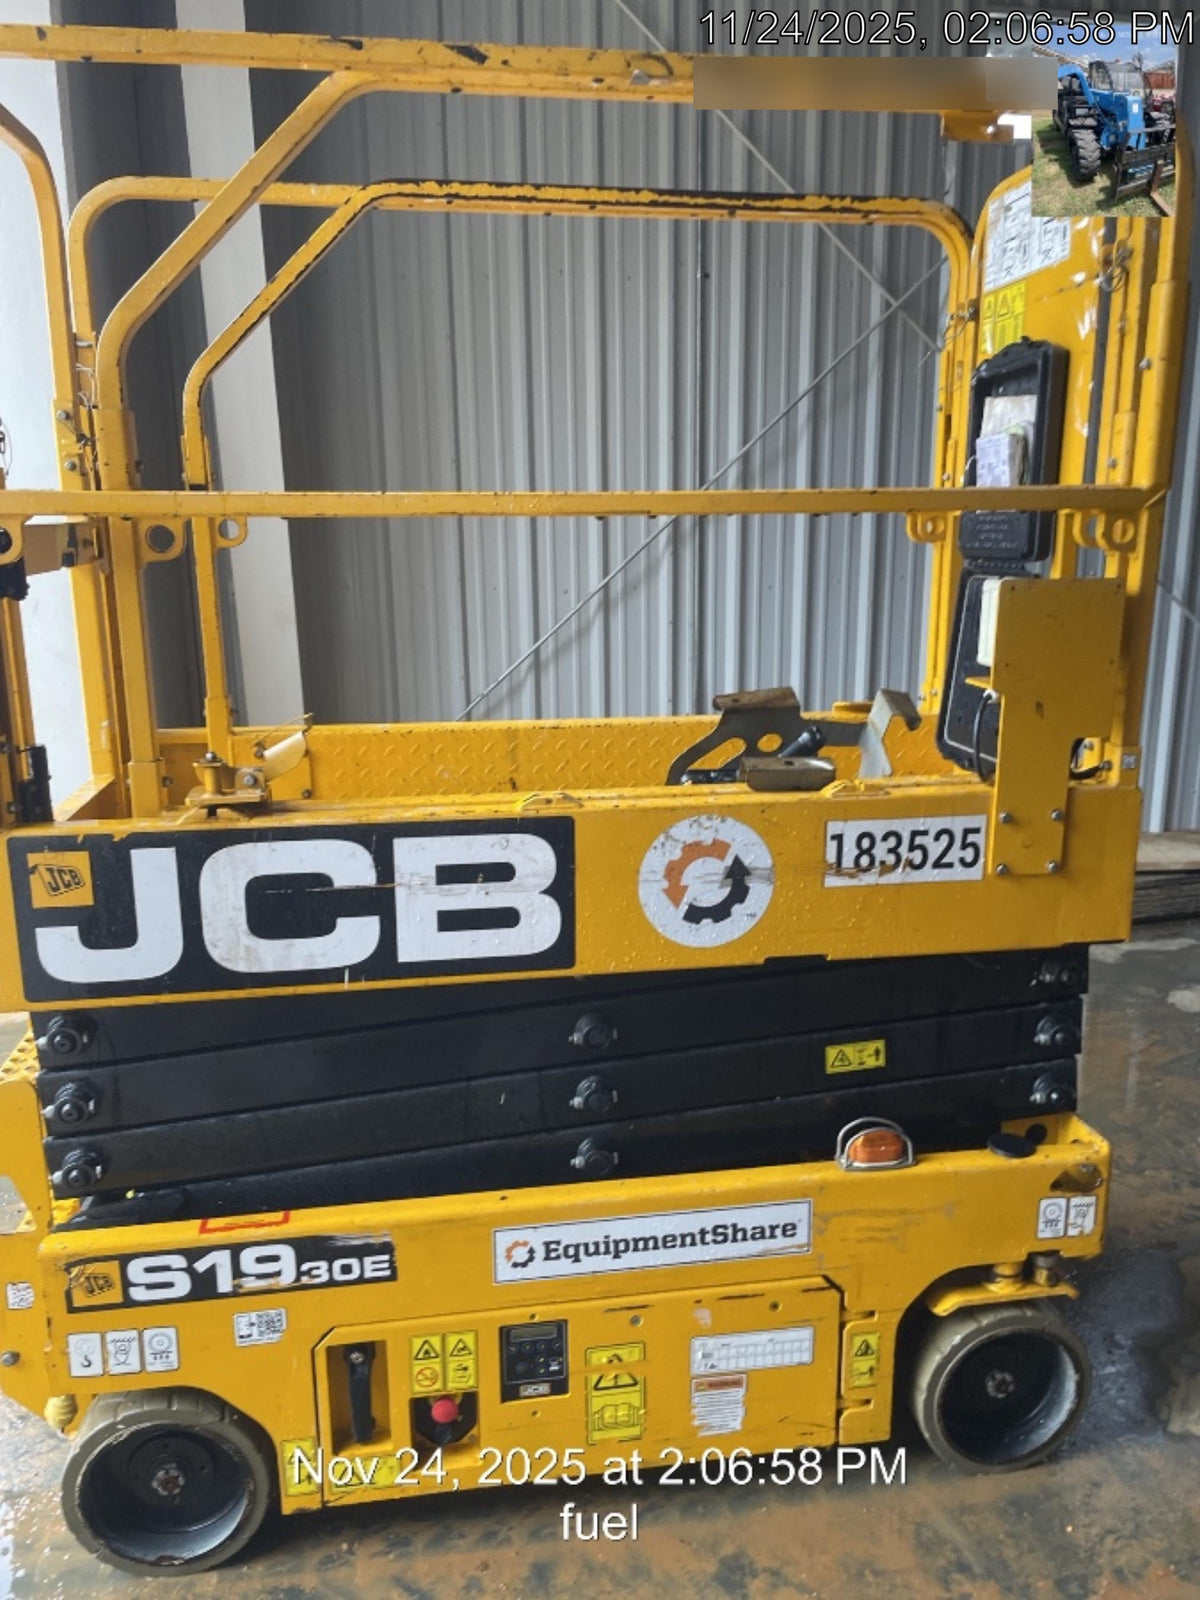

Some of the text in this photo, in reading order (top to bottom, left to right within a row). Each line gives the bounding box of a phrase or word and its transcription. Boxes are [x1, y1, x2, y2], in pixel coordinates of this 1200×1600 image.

[829, 827, 982, 871] 183525
[45, 866, 82, 892] JCB
[35, 832, 562, 984] JCB
[542, 1221, 799, 1264] EquipmentShare
